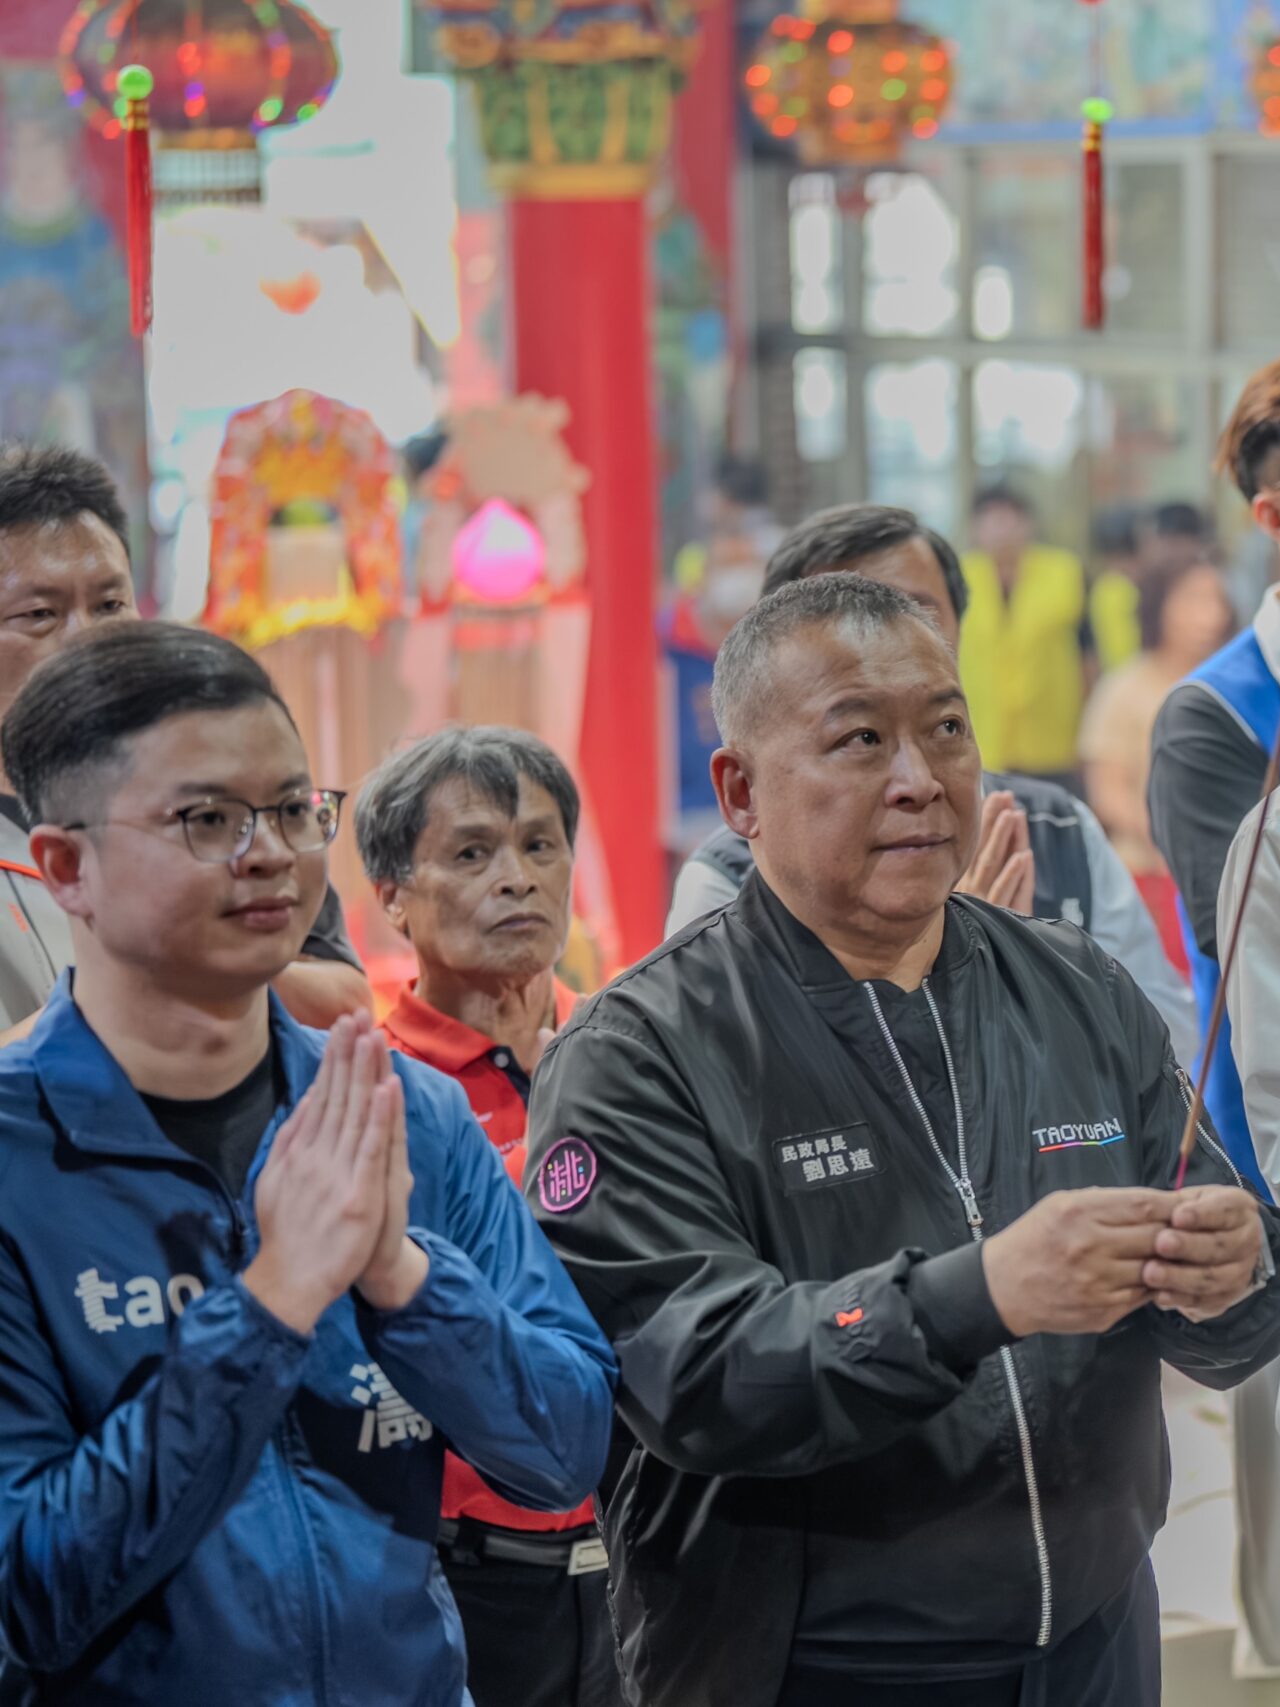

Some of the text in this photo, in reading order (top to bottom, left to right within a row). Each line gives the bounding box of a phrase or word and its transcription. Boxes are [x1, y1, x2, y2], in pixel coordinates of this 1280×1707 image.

[1032, 1117, 1122, 1147] TAOYUAN
[782, 1134, 848, 1163] 民政局長
[802, 1148, 875, 1183] 劉思遠
